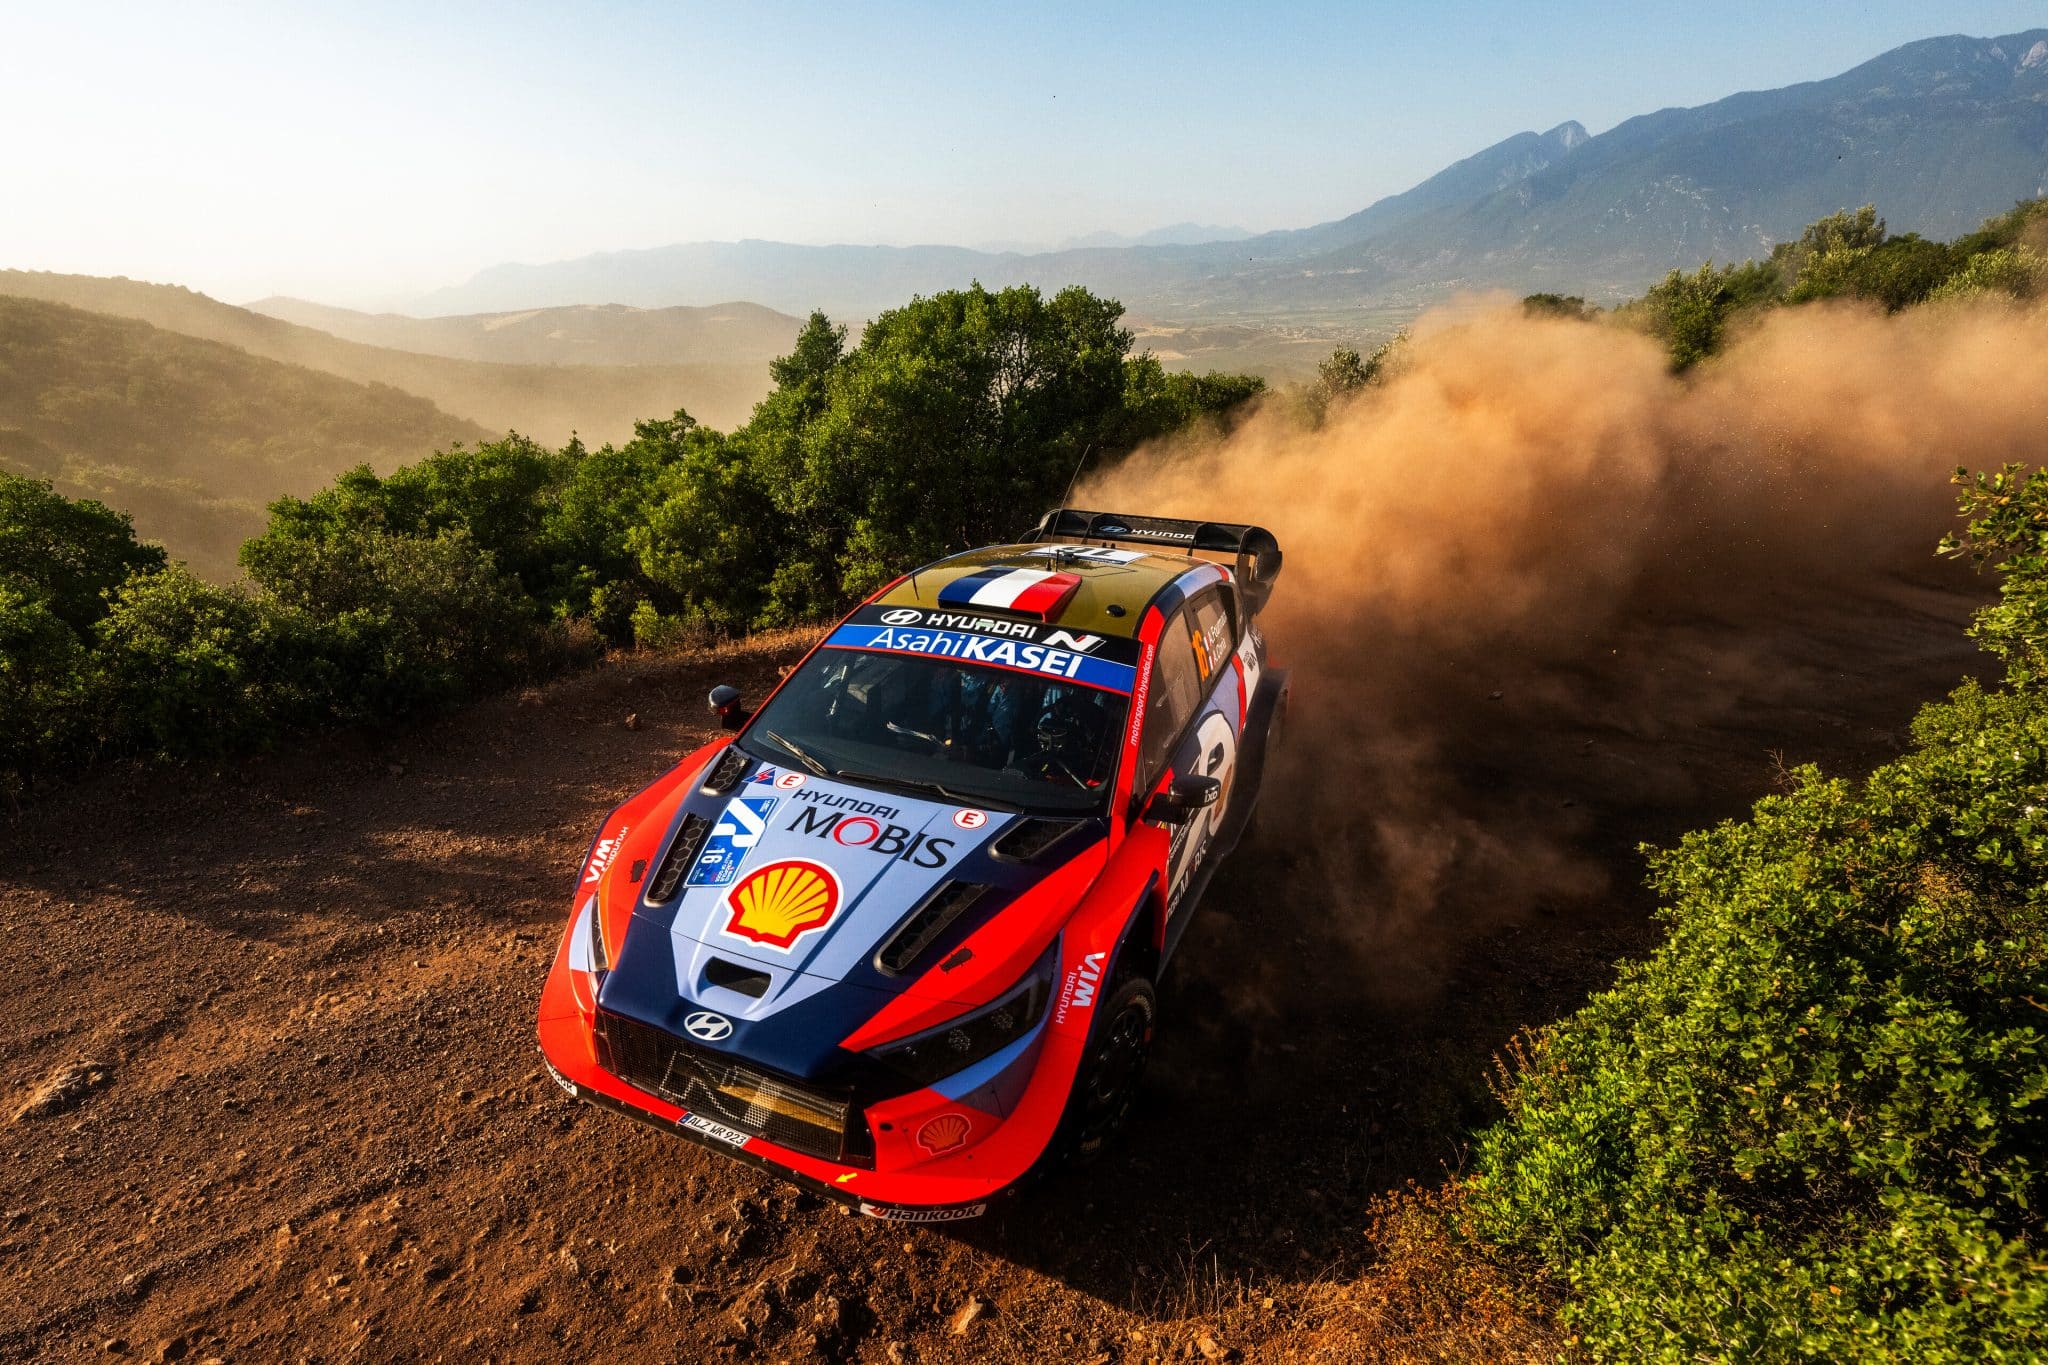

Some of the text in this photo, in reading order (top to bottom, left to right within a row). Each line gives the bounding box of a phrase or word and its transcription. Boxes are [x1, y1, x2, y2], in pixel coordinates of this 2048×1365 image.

[1131, 528, 1195, 541] HYUNDA
[926, 613, 1038, 639] HYUNDAI
[866, 628, 1083, 679] AsahiKASEI
[1130, 644, 1154, 747] motorsport.hyundai.com
[782, 775, 799, 786] E
[792, 788, 900, 820] HYUNDAI
[960, 812, 979, 825] E
[785, 805, 956, 869] MOBIS
[701, 847, 726, 864] 16
[1056, 971, 1078, 1025] HYUNDAI
[687, 1116, 747, 1146] ALZ WR 923
[888, 1205, 980, 1221] Hankook
